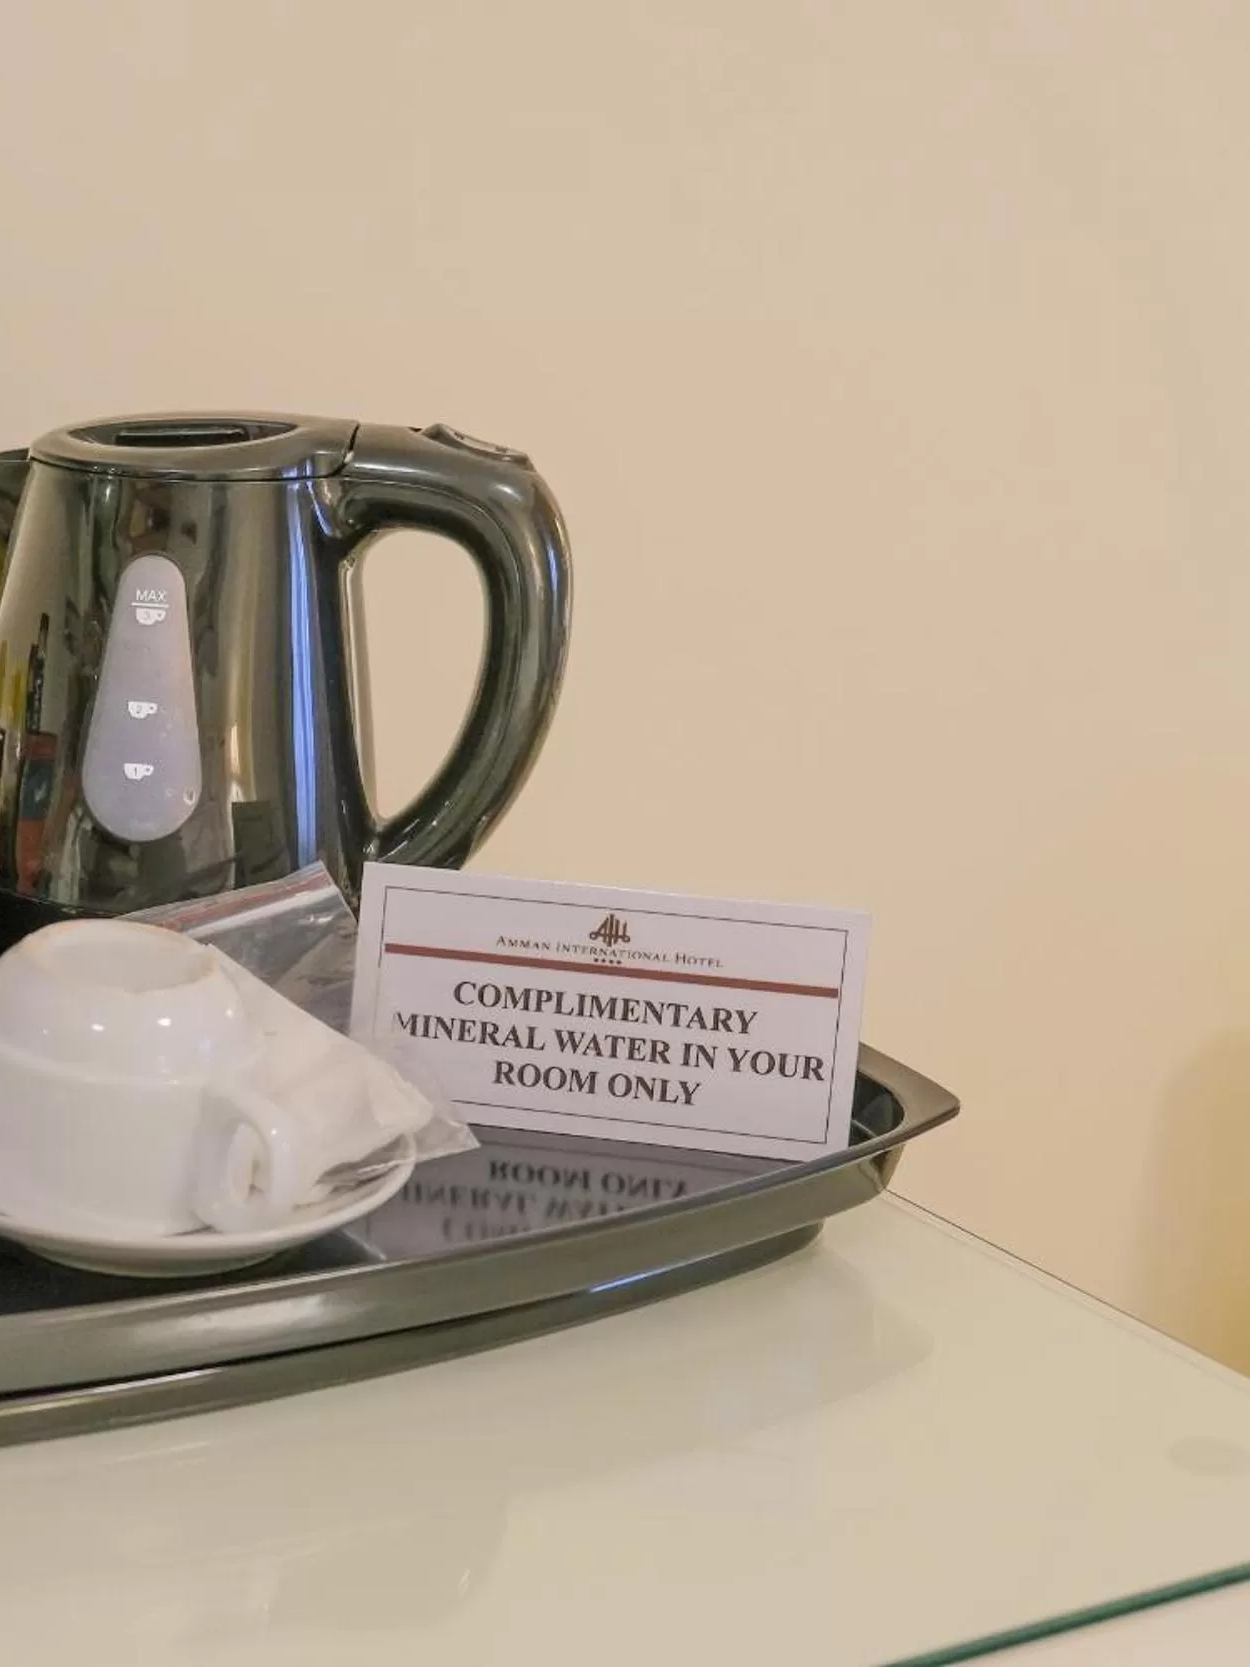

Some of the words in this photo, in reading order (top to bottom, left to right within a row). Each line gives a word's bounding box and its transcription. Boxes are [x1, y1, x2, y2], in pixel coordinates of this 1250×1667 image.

[136, 589, 166, 601] MAX
[556, 941, 670, 963] INTERNATIONAL
[675, 954, 724, 968] HOTEL
[452, 980, 758, 1035] COMPLIMENTARY
[393, 1011, 546, 1051] MINERAL
[554, 1029, 671, 1064] WATER
[681, 1042, 720, 1068] IN
[727, 1047, 825, 1081] YOUR
[493, 1060, 599, 1094] ROOM
[608, 1073, 702, 1106] ONLY
